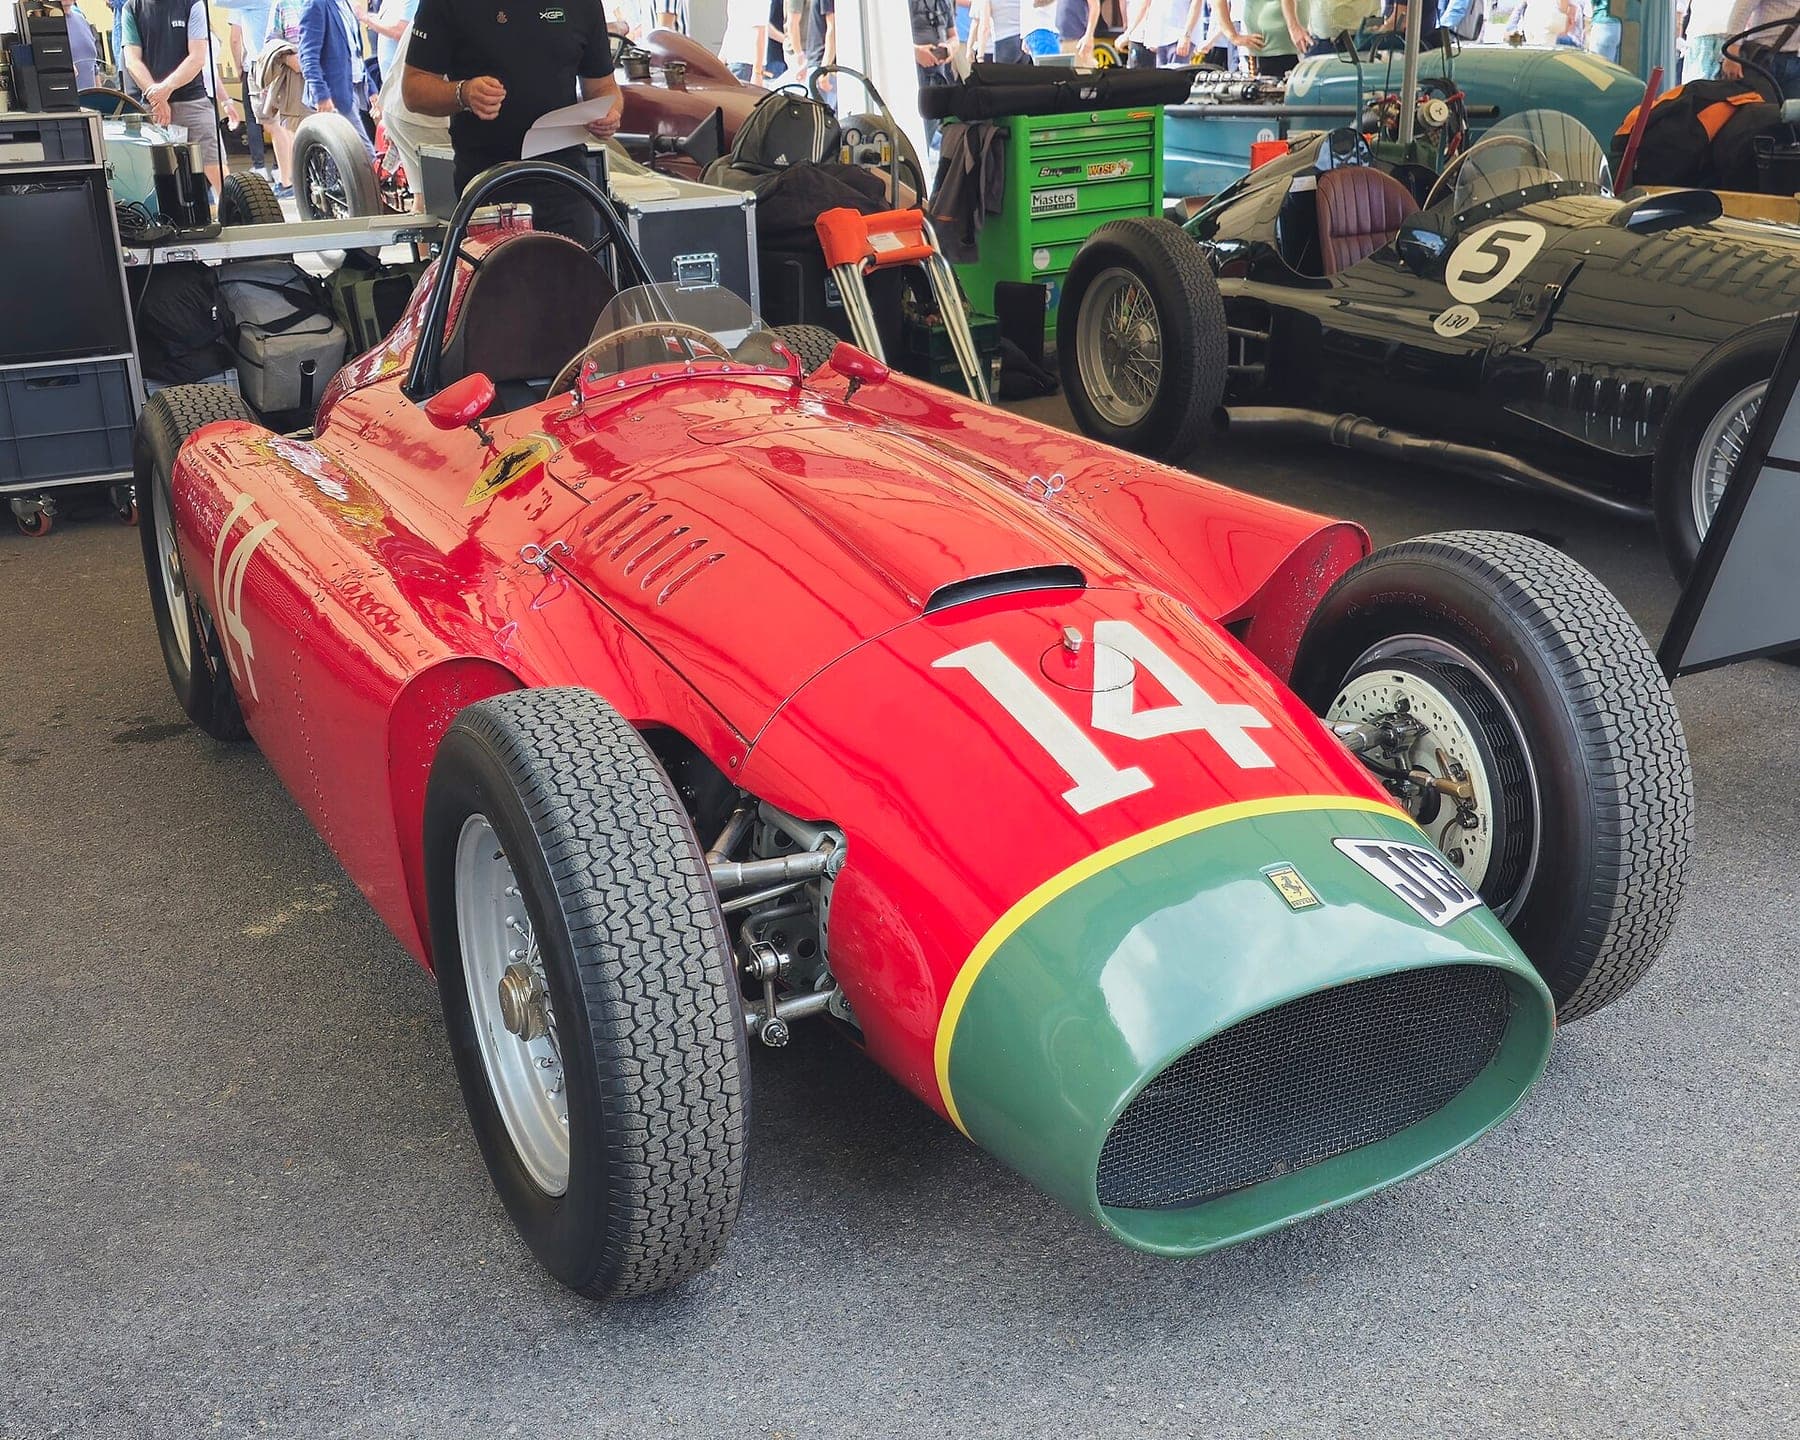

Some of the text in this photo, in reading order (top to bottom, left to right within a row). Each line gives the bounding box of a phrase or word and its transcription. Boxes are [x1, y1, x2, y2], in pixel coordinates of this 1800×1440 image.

[539, 11, 564, 19] XGP
[1087, 163, 1117, 177] WOSP
[1032, 193, 1075, 206] Masters
[1457, 230, 1532, 284] 5
[1440, 313, 1470, 329] 130
[213, 493, 280, 703] 14
[931, 620, 1276, 815] 14
